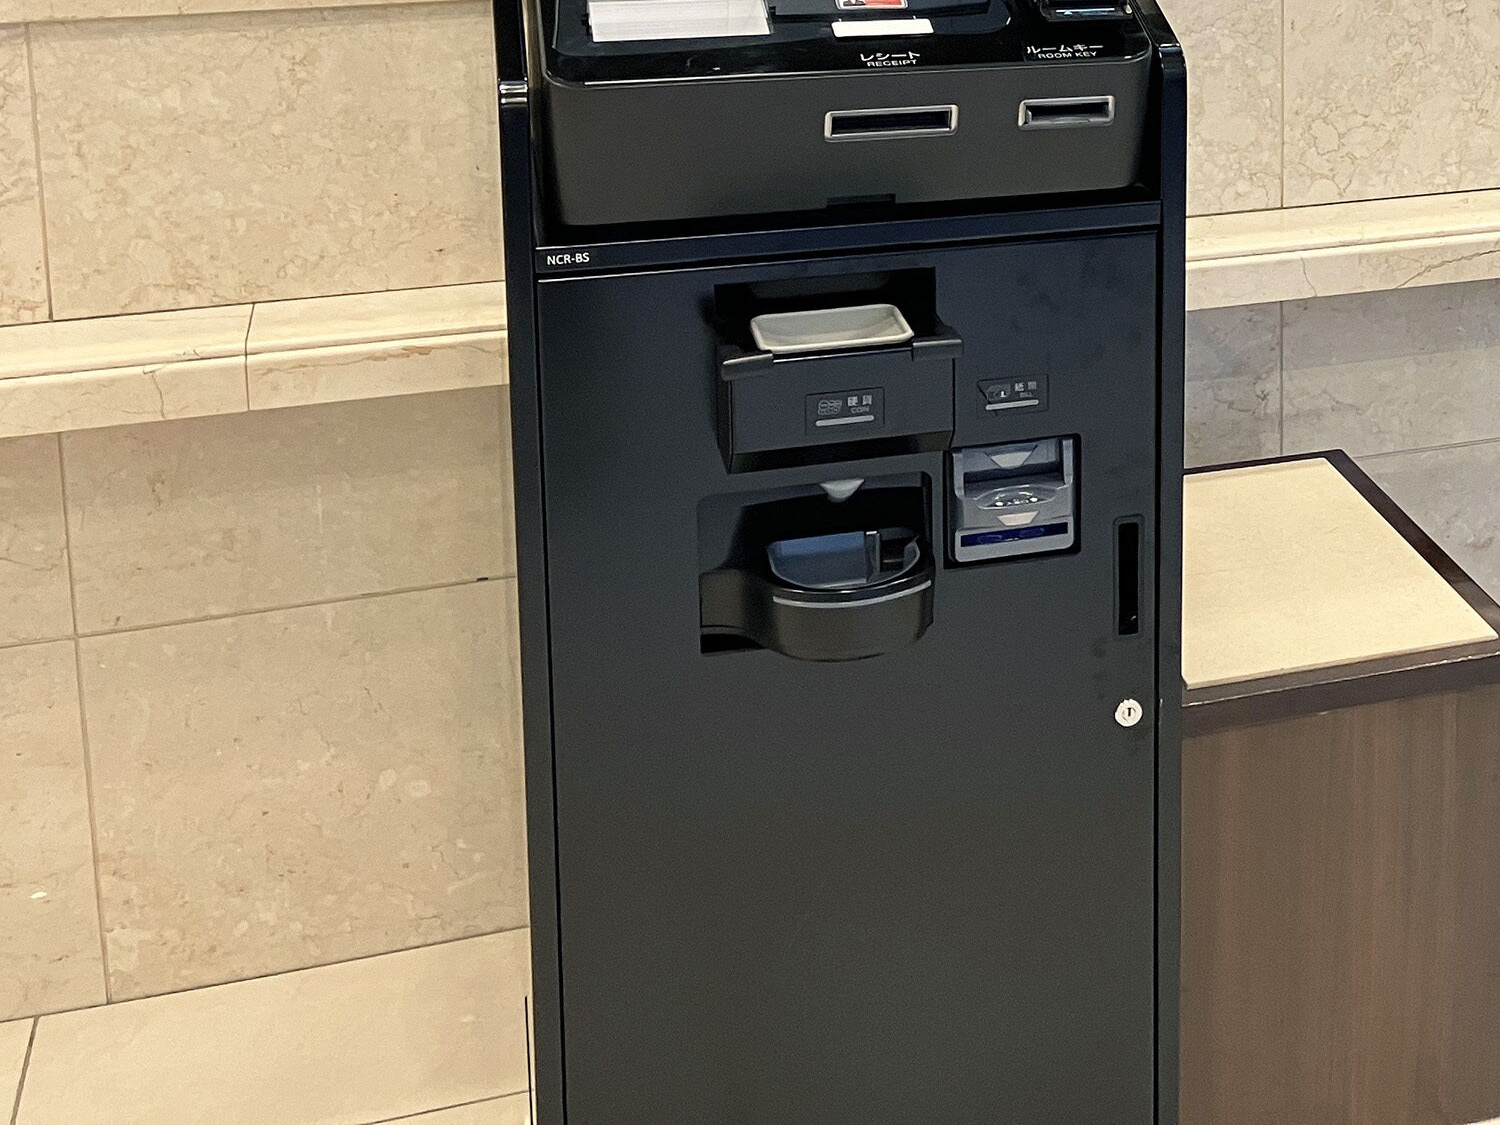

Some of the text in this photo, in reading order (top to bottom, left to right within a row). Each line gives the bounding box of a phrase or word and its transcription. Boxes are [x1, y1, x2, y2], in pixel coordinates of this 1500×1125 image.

[1026, 43, 1104, 54] ルームキー
[860, 51, 921, 61] レシート
[1074, 50, 1097, 58] KEY
[866, 59, 917, 67] RECEIPT
[546, 252, 590, 266] NCR-BS
